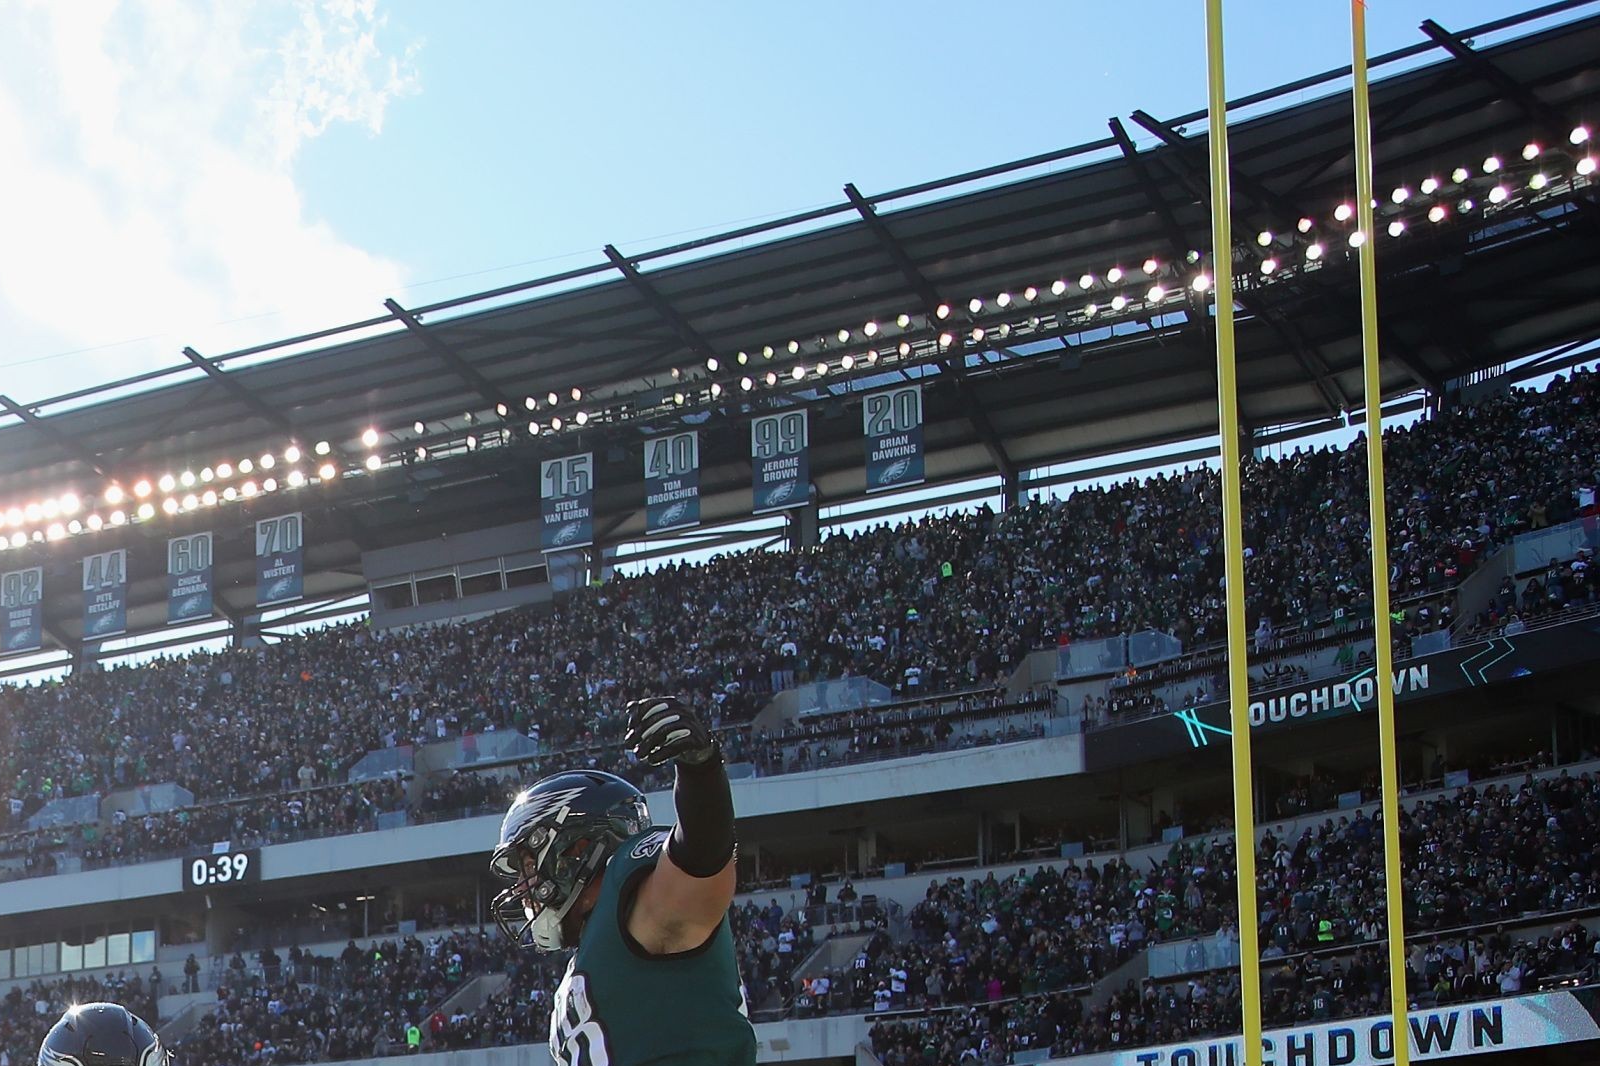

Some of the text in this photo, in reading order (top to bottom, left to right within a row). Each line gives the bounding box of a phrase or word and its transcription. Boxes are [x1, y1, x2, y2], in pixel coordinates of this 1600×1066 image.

[868, 390, 918, 437] 20
[756, 413, 804, 459] 99
[880, 435, 908, 449] BRIAN
[649, 434, 696, 480] 40
[762, 457, 799, 472] JEROME
[872, 444, 917, 461] DAWKINS
[545, 457, 588, 500] 15
[662, 480, 681, 491] TOM
[763, 468, 798, 482] BROWN
[554, 500, 579, 512] STEVE
[647, 487, 698, 505] BROOKSHIER
[544, 508, 589, 524] VAN BUREN
[260, 516, 298, 558] 70
[171, 535, 210, 575] 60
[274, 558, 284, 567] AL
[87, 552, 122, 592] 44
[263, 565, 296, 579] WISTERT
[4, 569, 40, 608] 92
[1232, 664, 1429, 728] OUCHDON
[192, 853, 248, 885] 0:39
